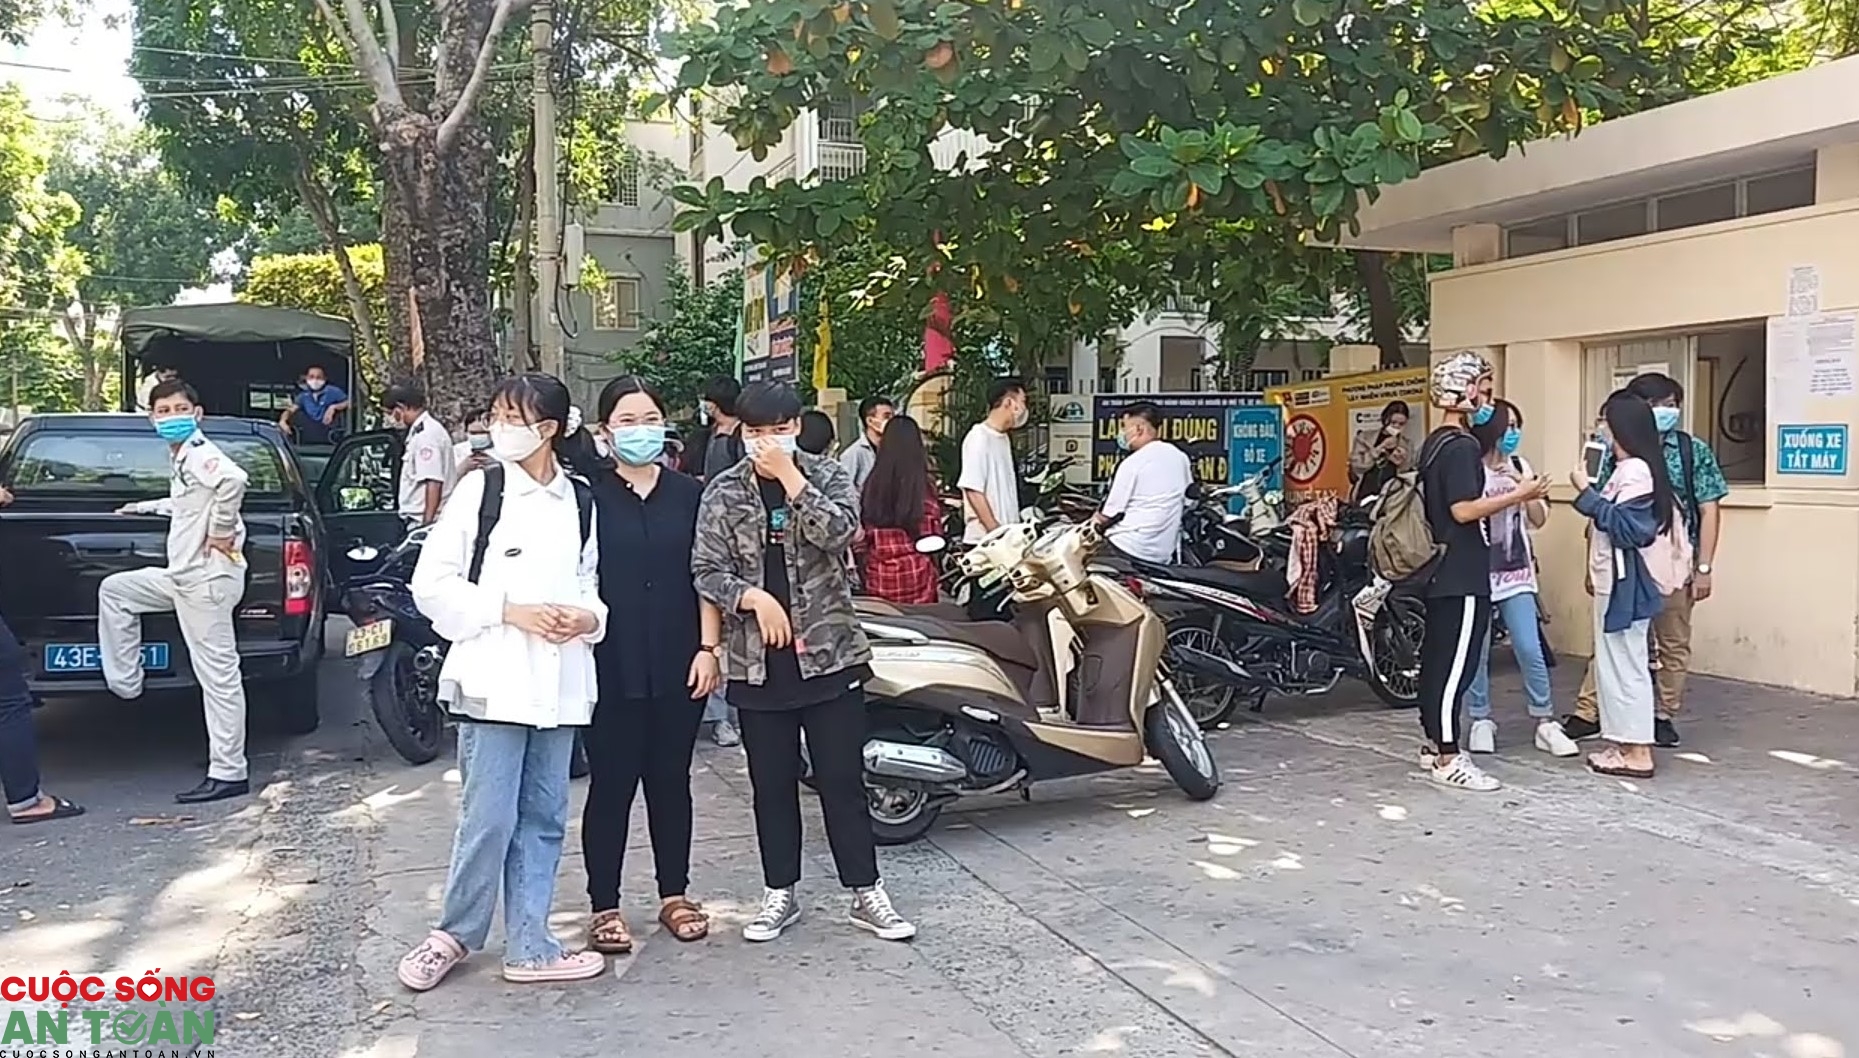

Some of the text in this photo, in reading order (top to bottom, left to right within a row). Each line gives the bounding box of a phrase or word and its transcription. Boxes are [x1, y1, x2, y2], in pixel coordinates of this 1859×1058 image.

[1172, 413, 1218, 441] ĐÚNG
[1783, 428, 1842, 448] XUỐNG XE
[1811, 451, 1838, 469] MÁY
